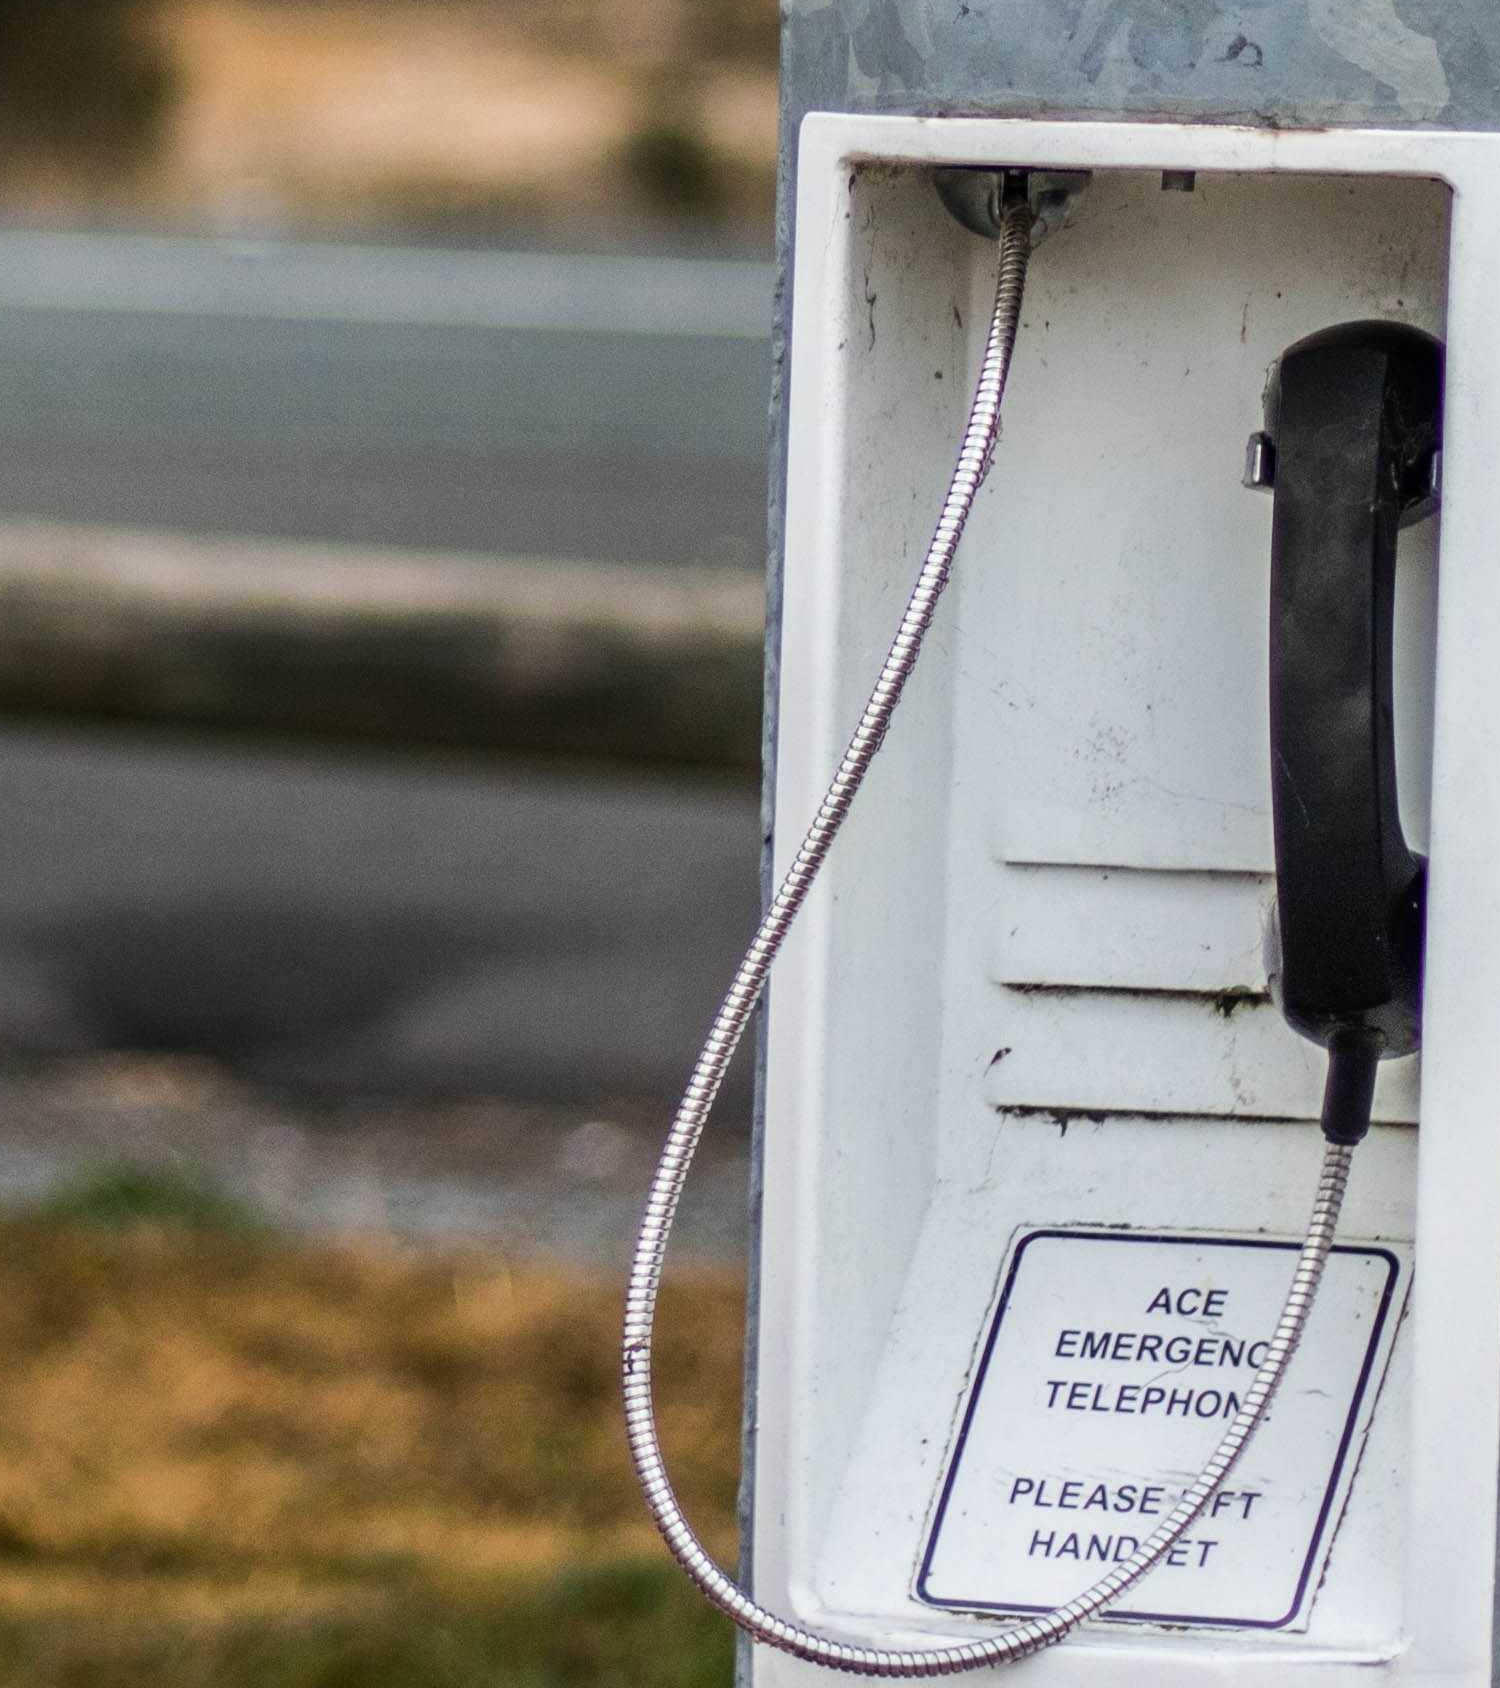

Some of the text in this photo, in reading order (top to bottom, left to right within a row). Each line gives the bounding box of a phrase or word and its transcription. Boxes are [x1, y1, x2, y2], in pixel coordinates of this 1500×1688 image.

[1146, 1287, 1229, 1317] ACE
[1054, 1330, 1299, 1369] EMERGENC
[1046, 1381, 1270, 1421] TELEPHON
[1009, 1477, 1262, 1520] PLEASE FT
[1028, 1530, 1219, 1568] HANDET
